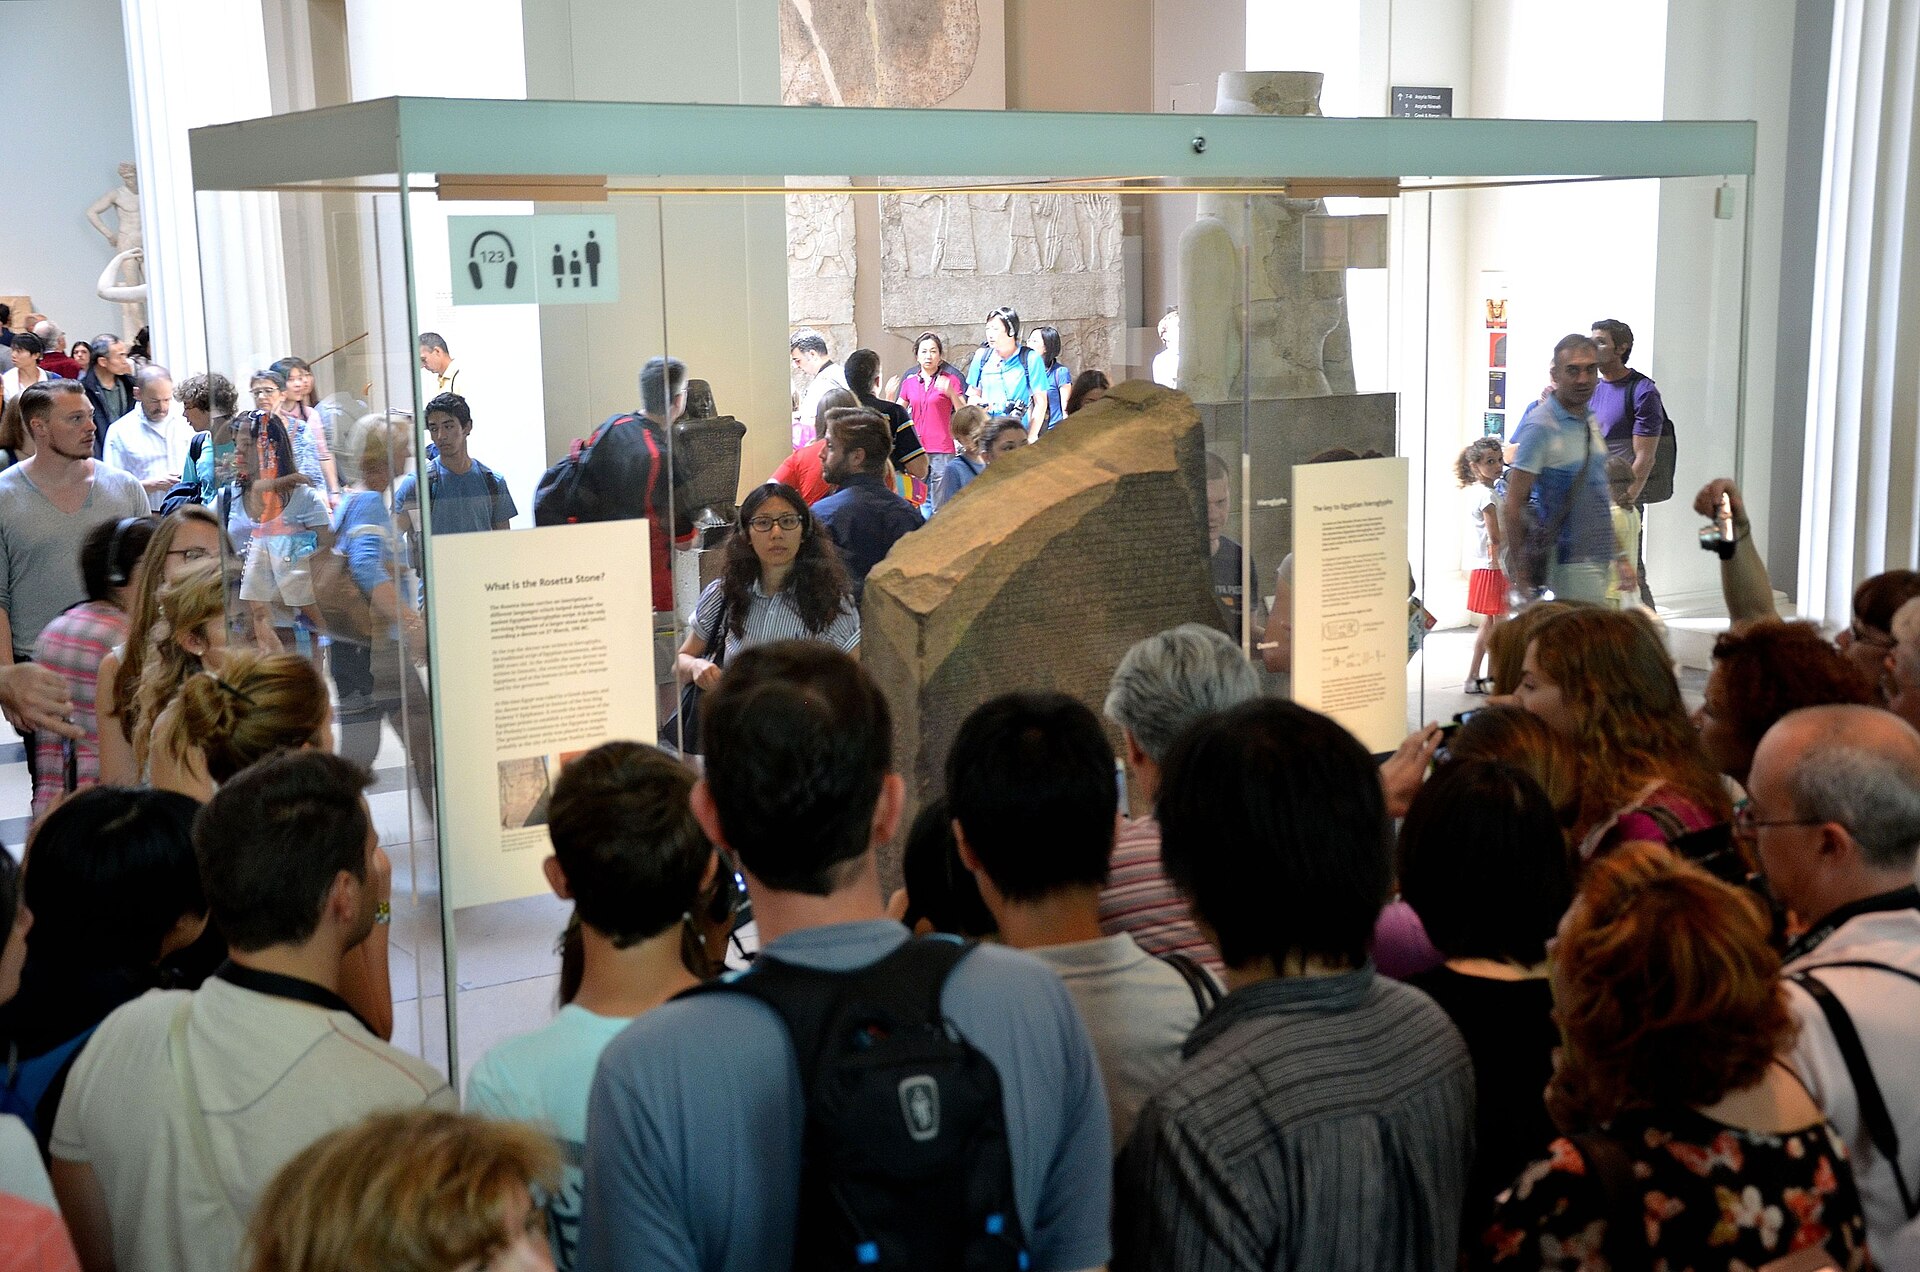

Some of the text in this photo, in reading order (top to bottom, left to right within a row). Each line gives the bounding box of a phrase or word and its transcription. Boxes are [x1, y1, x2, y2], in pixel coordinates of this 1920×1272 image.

[480, 250, 505, 263] 123
[485, 572, 606, 592] What is the Rosetta Stone?
